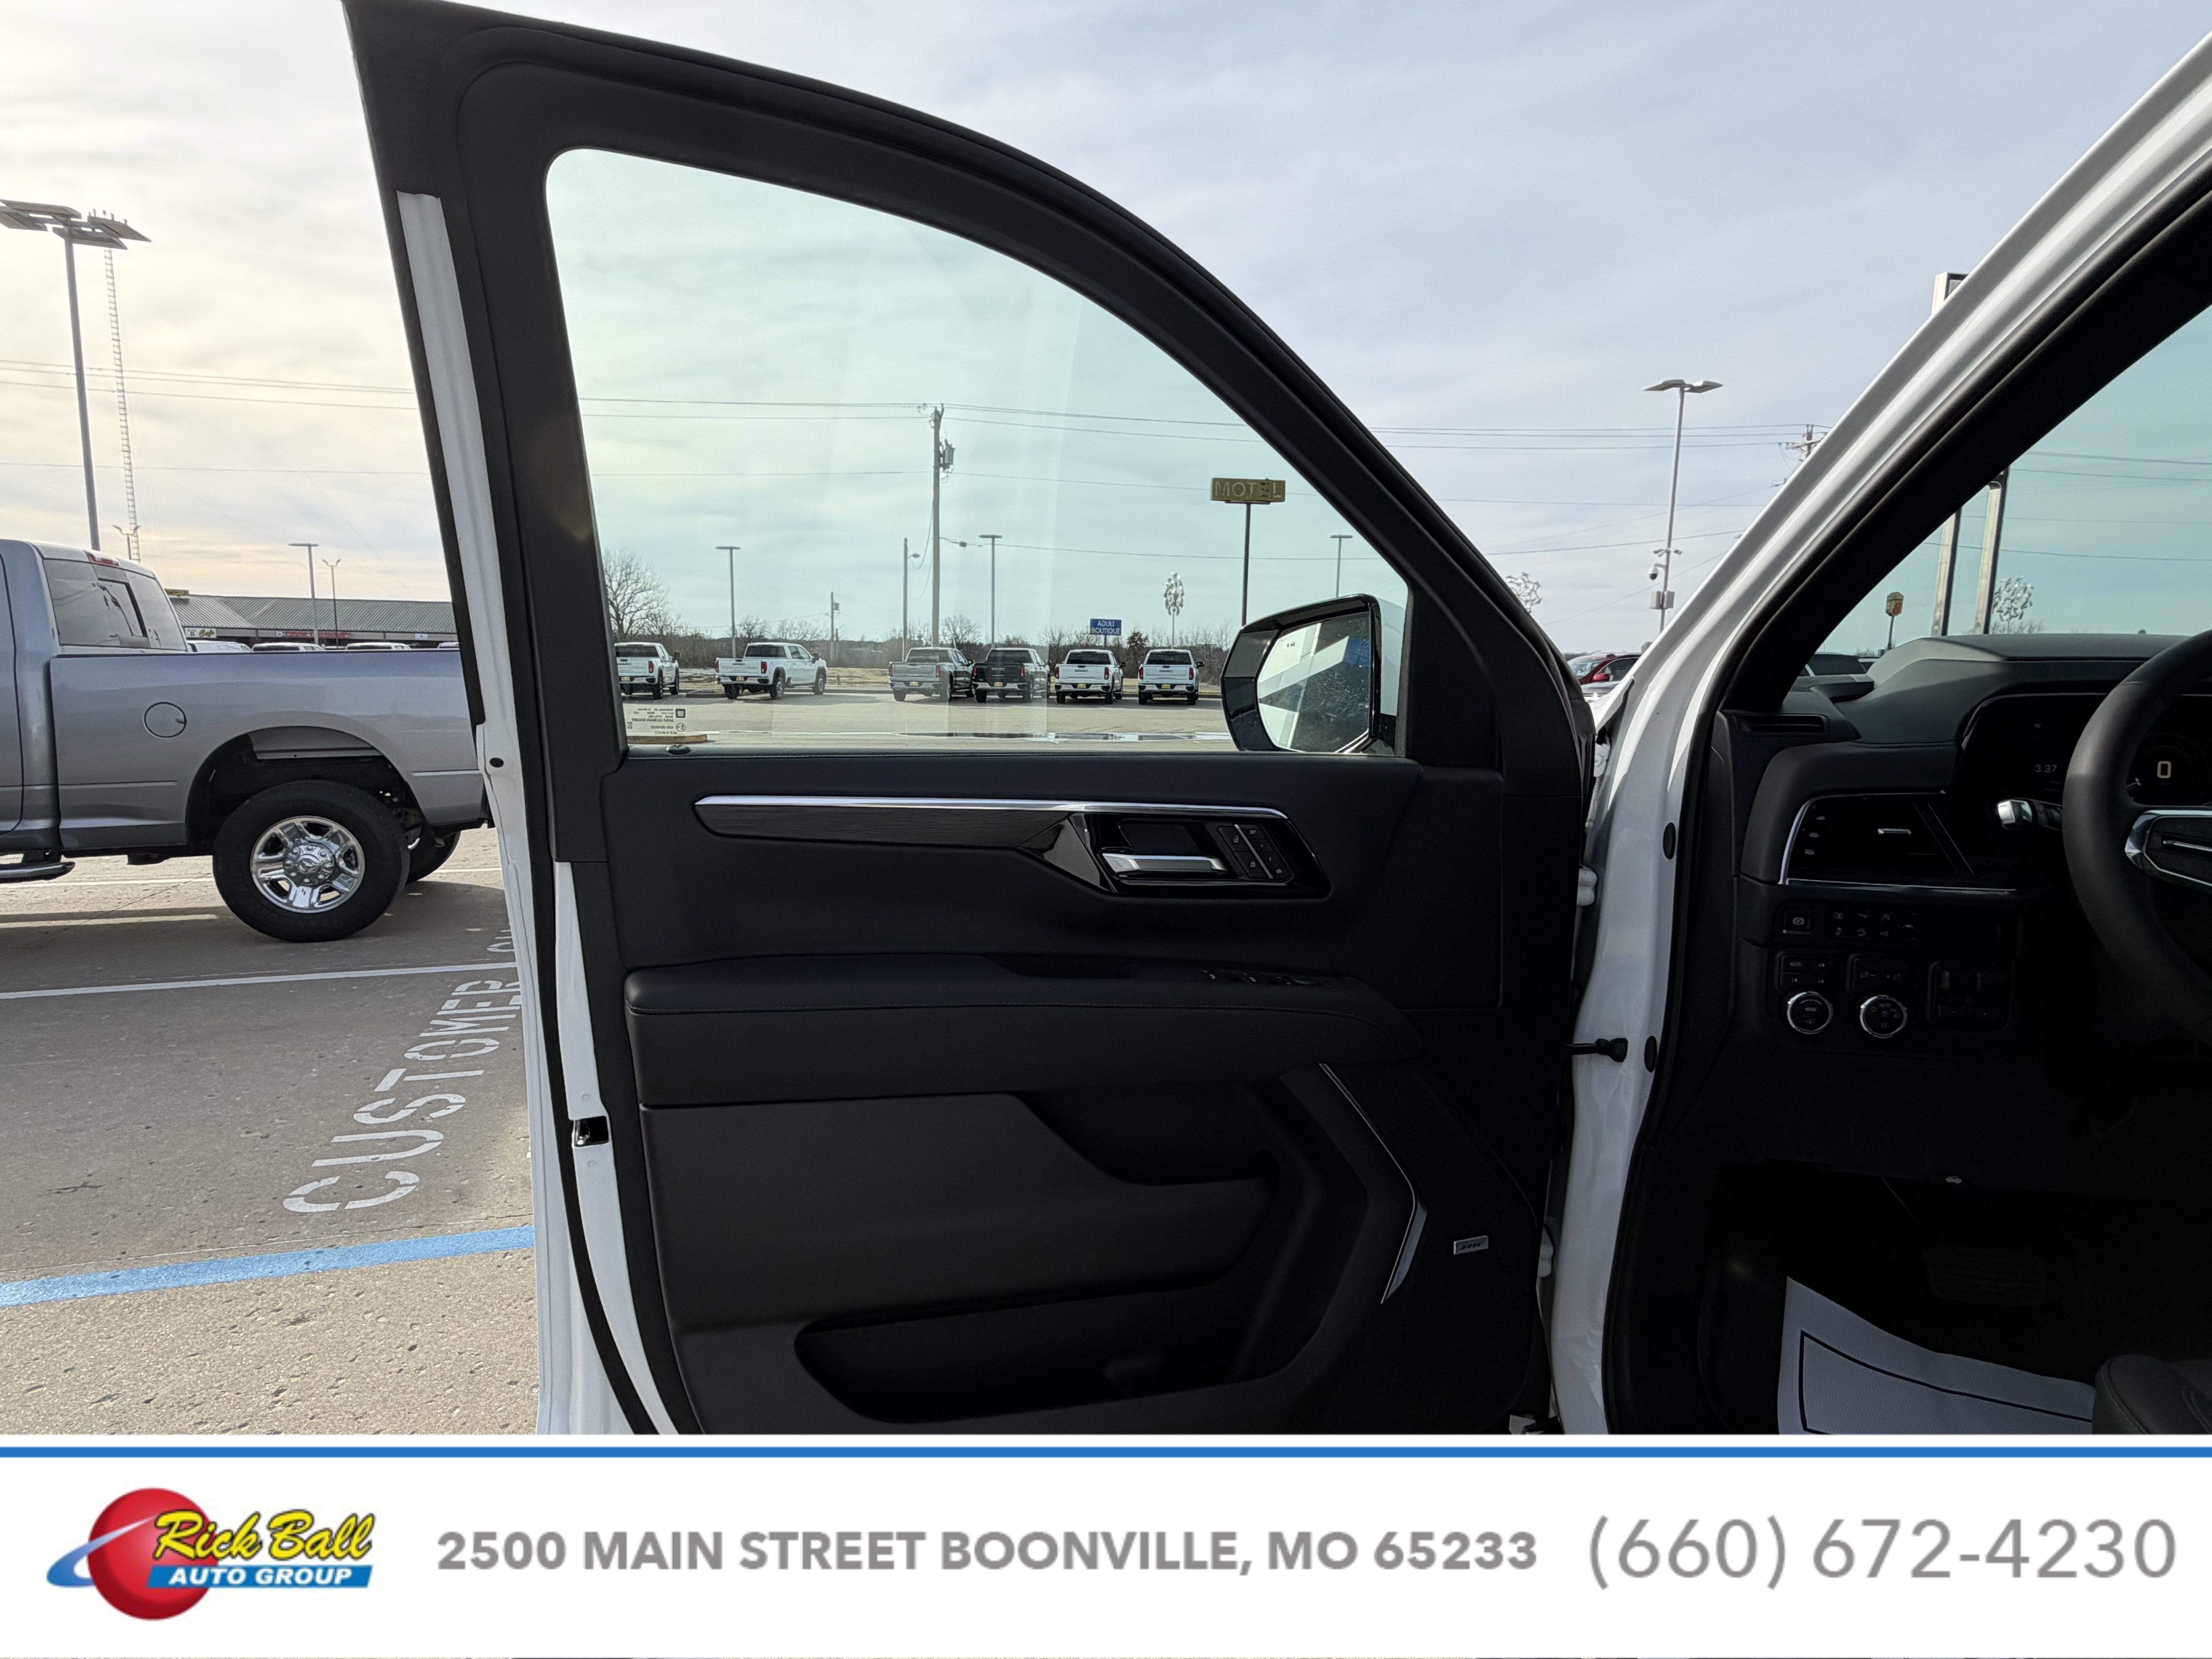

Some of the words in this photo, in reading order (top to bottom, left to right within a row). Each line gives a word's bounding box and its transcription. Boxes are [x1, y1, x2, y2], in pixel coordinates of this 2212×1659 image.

[2035, 764, 2057, 773] 3:37
[2157, 761, 2172, 778] 0
[283, 980, 522, 1212] CUSTOMER
